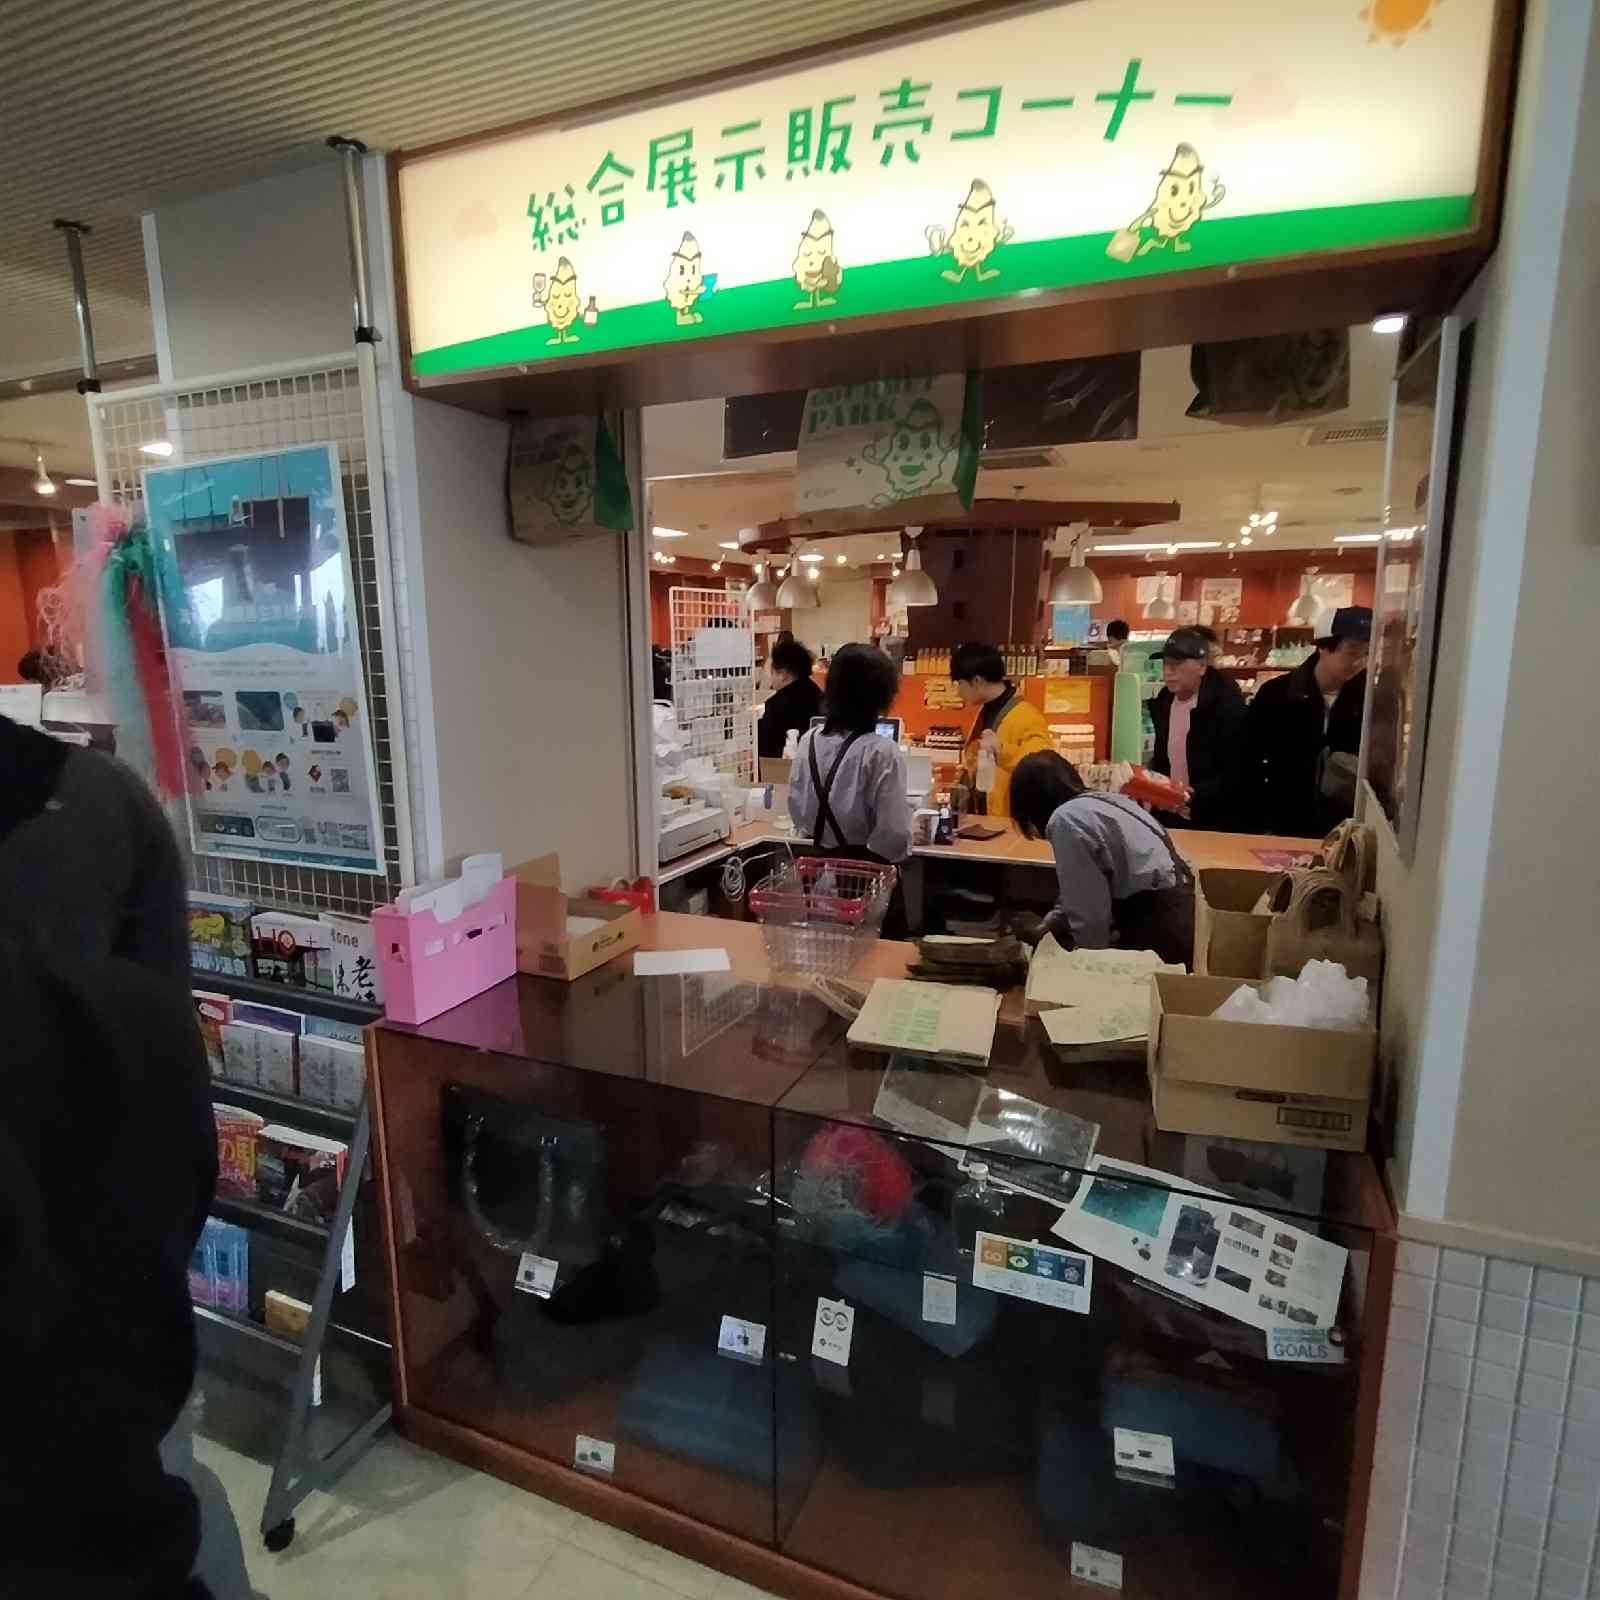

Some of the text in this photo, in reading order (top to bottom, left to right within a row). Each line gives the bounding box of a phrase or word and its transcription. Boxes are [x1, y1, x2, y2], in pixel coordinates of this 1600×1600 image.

[527, 57, 1234, 253] 総合展示販売コーナー
[1273, 1343, 1329, 1360] GOALS
